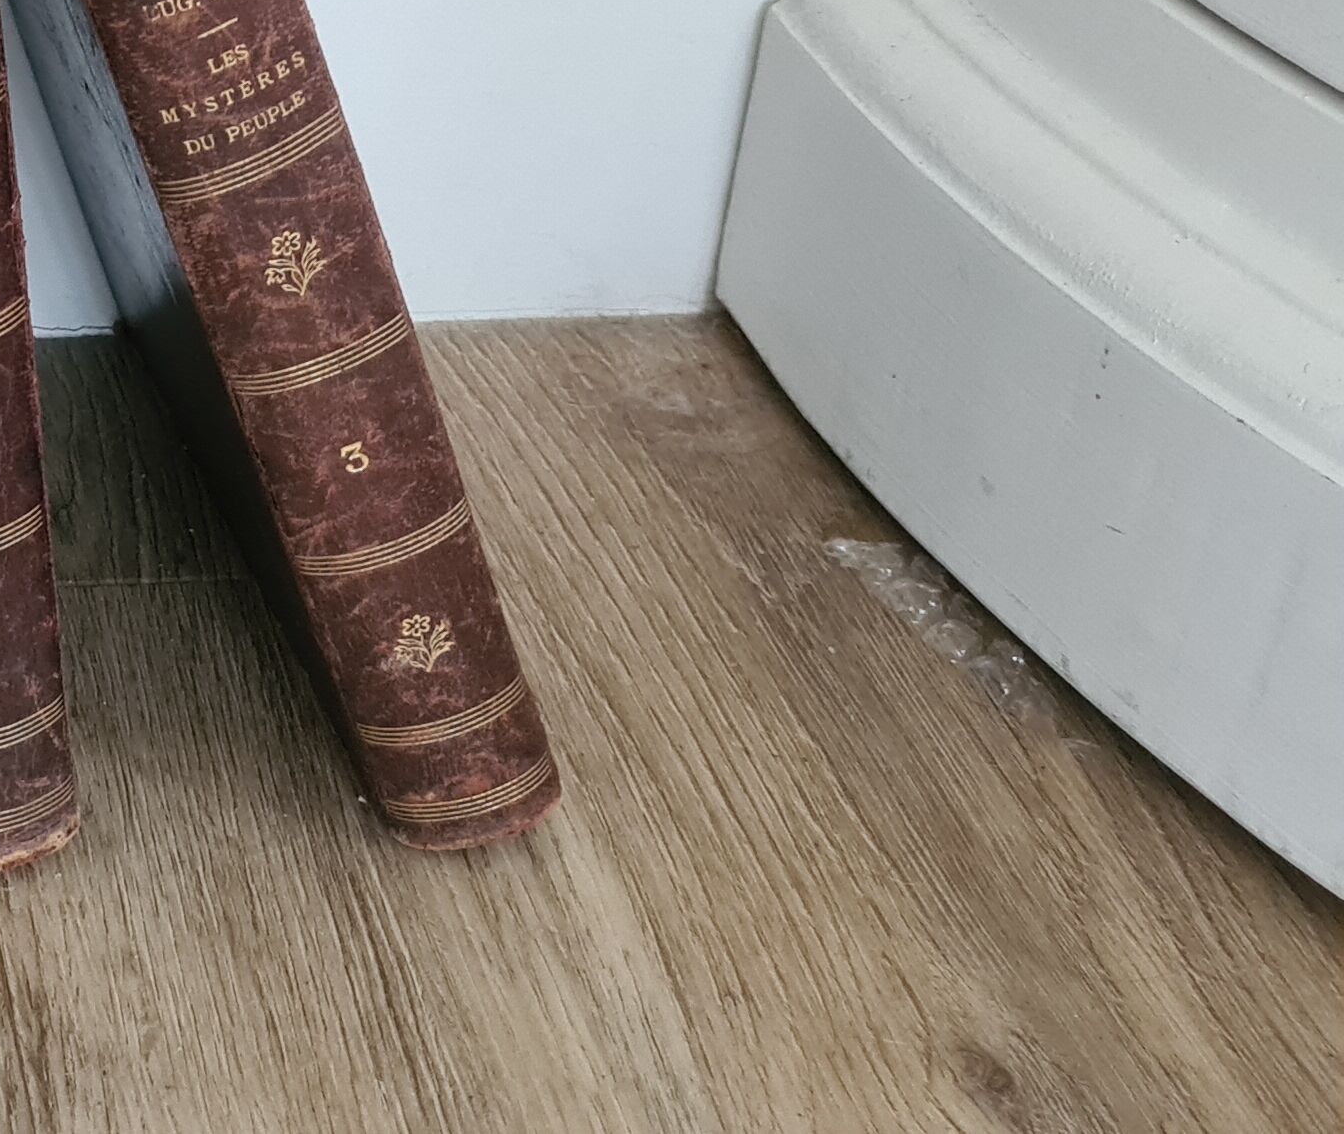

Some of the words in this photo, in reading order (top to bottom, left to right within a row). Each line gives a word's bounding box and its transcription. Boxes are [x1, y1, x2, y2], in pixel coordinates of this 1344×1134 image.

[207, 44, 250, 74] LES
[160, 51, 305, 124] MYSTÈRES
[183, 134, 216, 155] DU
[225, 90, 306, 143] PEUPLE
[340, 441, 370, 473] 3
